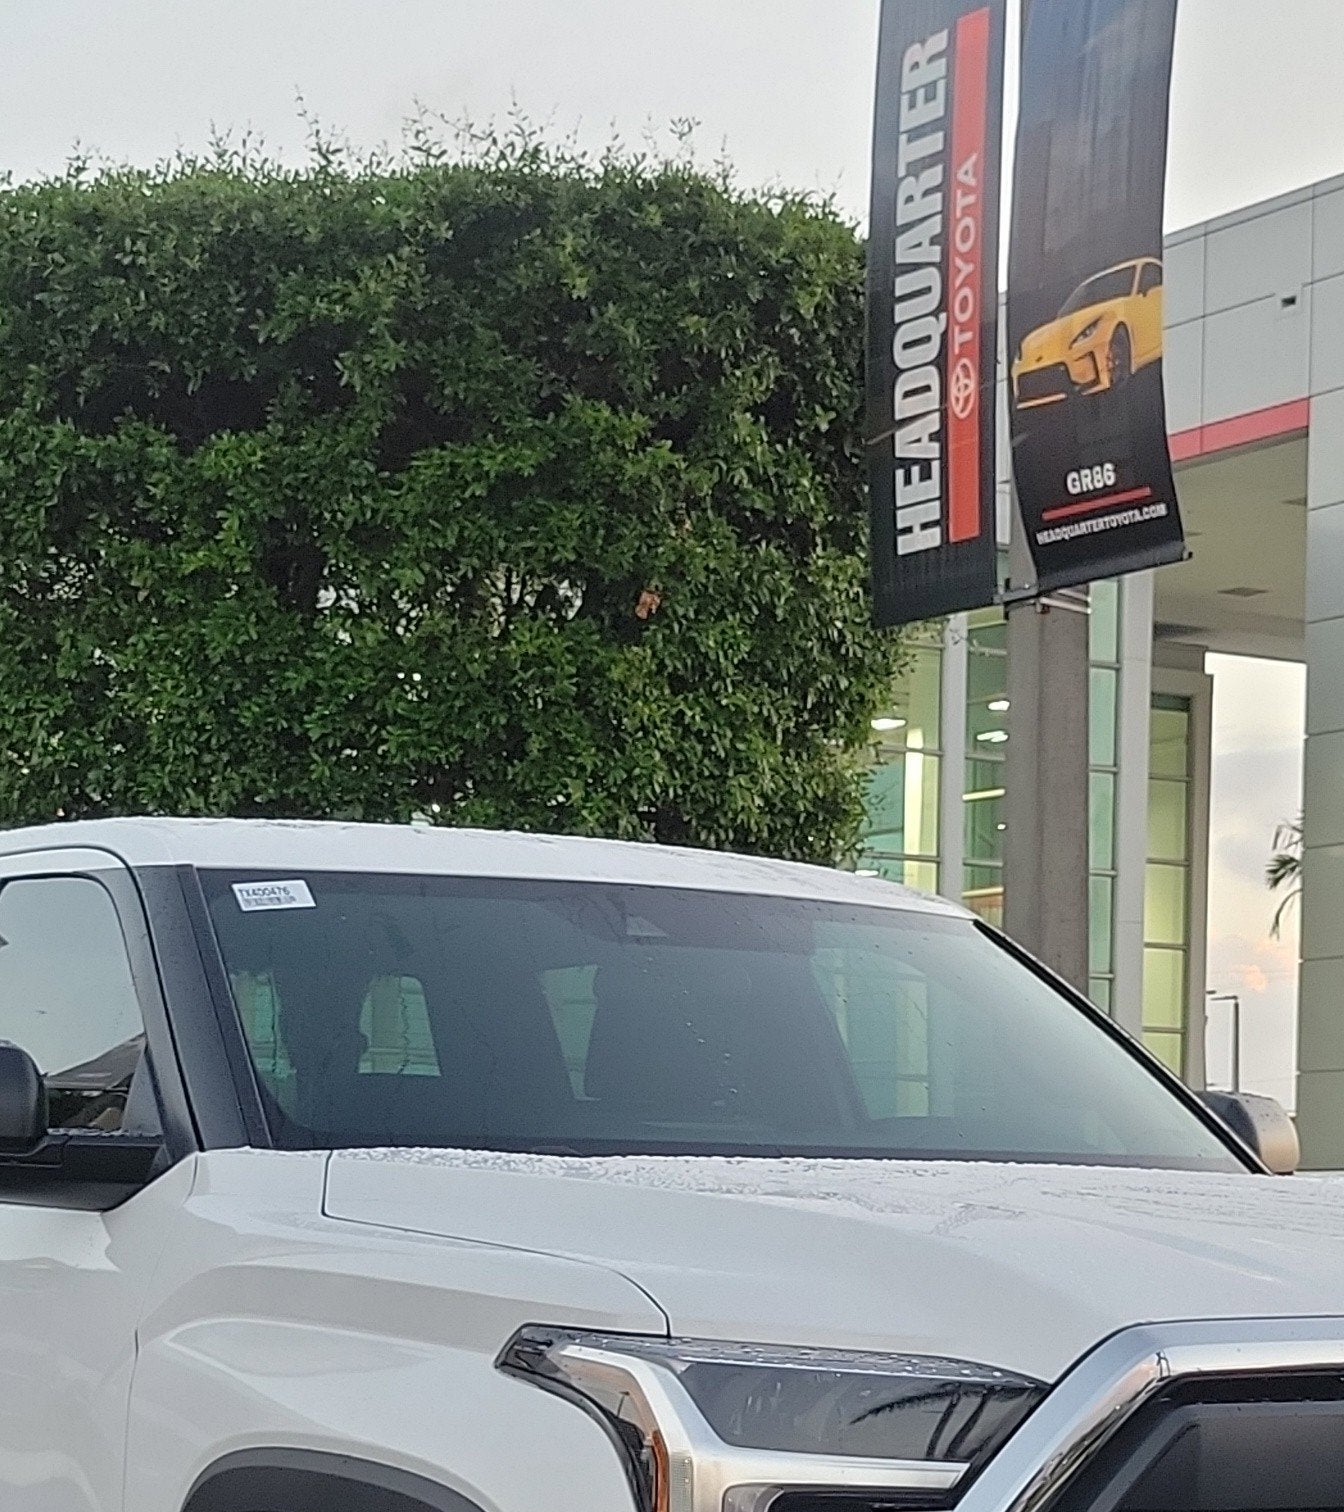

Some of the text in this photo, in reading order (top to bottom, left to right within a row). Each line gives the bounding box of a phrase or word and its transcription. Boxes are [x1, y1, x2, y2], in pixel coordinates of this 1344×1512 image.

[893, 28, 949, 556] HEADQUARTER
[952, 152, 980, 355] TOYOTA
[1036, 502, 1168, 546] HEADQUARTERTOYOTA.COM
[1066, 462, 1117, 495] GR86
